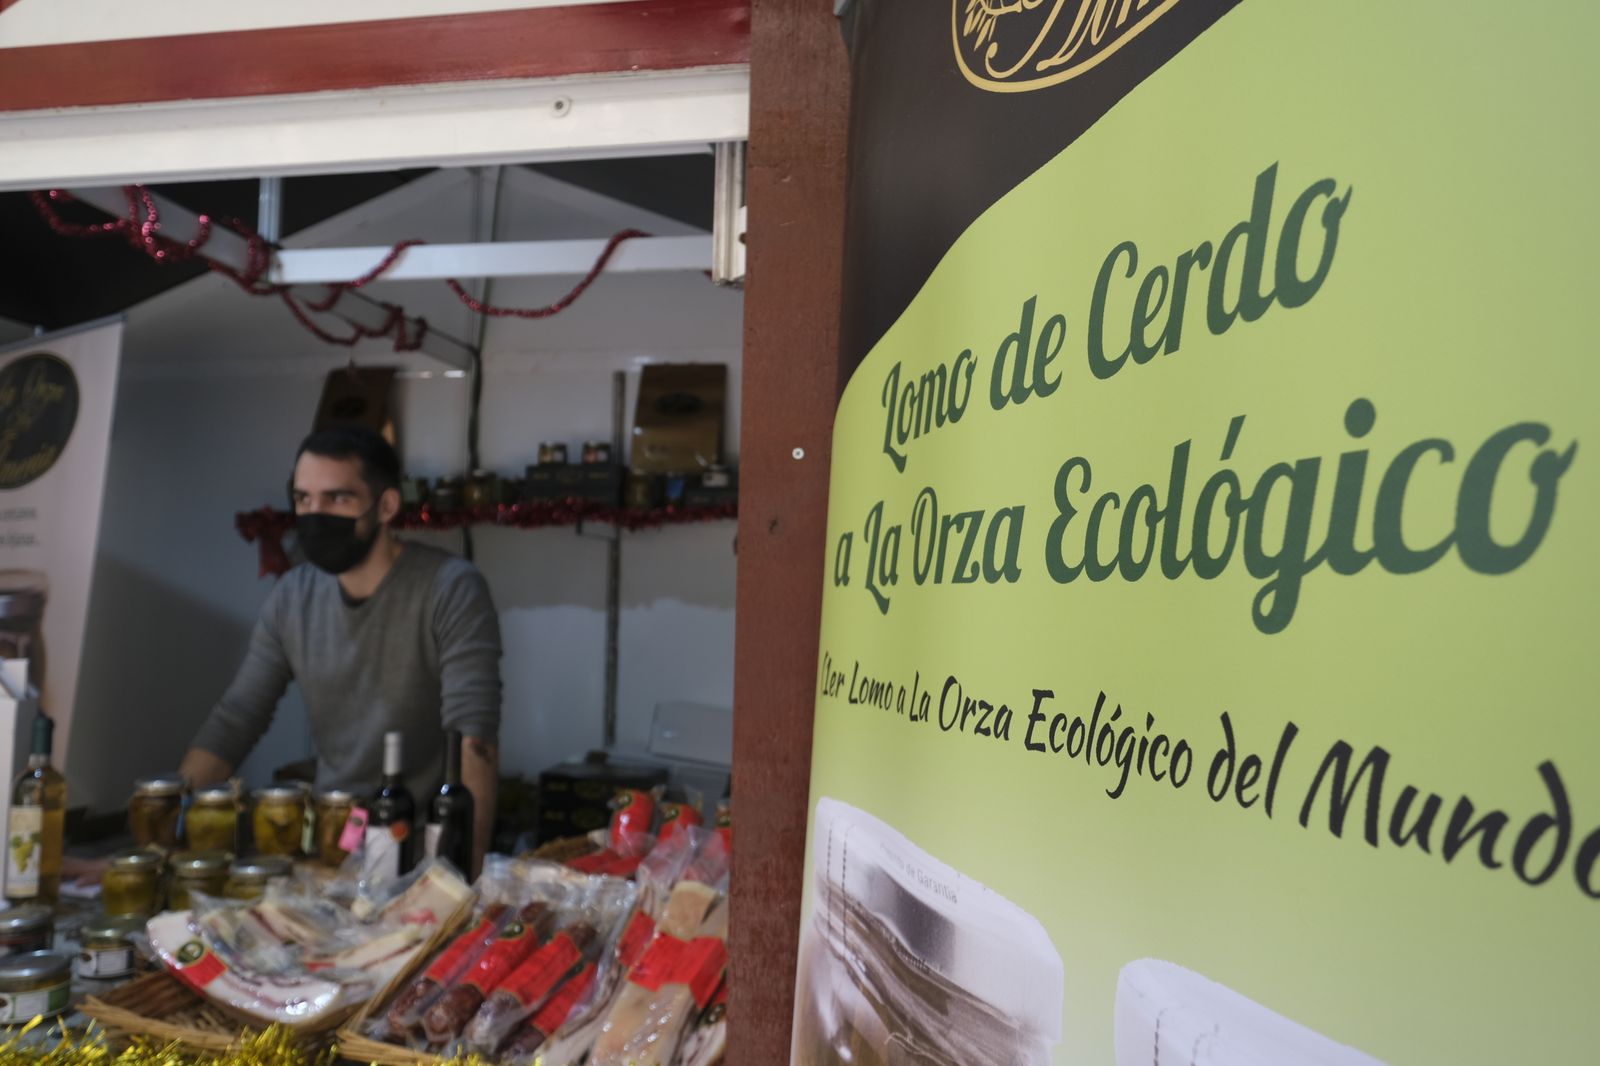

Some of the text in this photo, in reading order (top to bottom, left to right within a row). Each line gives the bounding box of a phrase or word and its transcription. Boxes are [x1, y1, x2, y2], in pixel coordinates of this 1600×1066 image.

[881, 161, 1353, 474] Lomo de Cerdo
[834, 397, 1578, 635] a La Orza Ecológico
[848, 660, 894, 711] Lomo
[897, 685, 906, 715] a
[909, 670, 931, 723] La
[938, 675, 1014, 741] Orza
[1023, 688, 1193, 800] Ecológico
[1206, 710, 1300, 820] del
